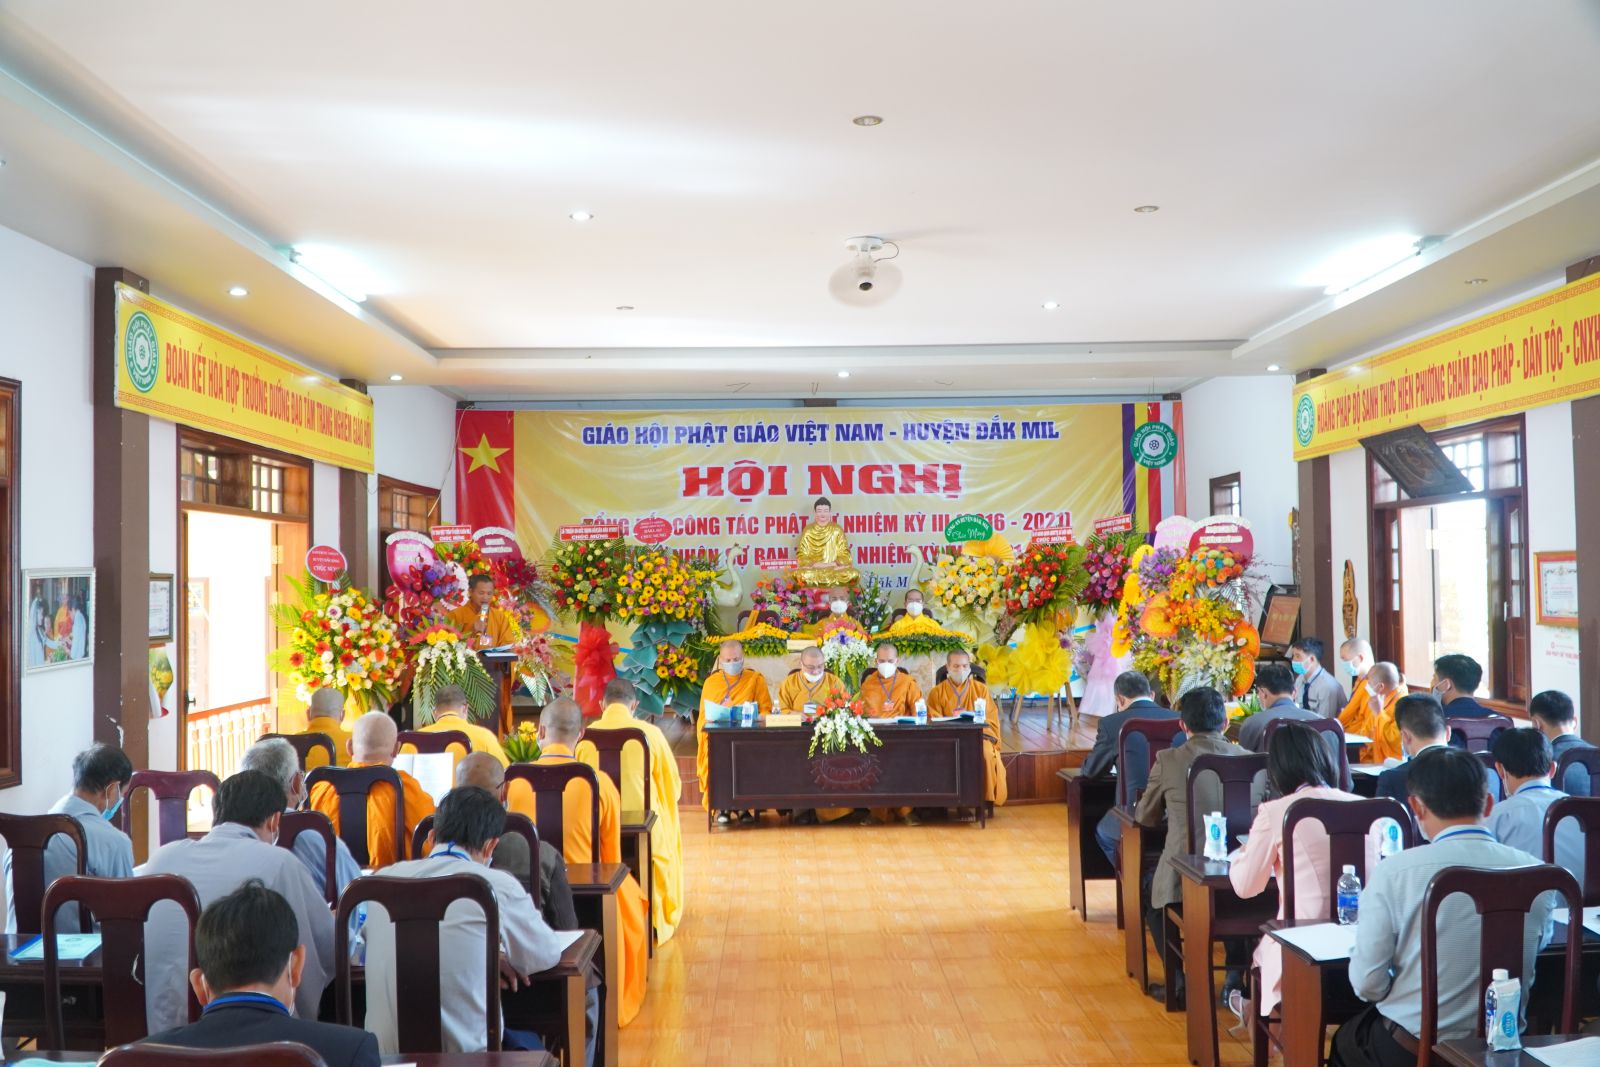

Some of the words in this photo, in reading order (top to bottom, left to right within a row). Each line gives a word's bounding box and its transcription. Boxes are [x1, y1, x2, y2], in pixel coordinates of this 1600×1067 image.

[1447, 350, 1470, 400] CHÂM
[1472, 350, 1488, 400] ĐẠO
[1491, 335, 1514, 388] PHÁP
[1522, 326, 1542, 380] DÂN
[1544, 319, 1563, 382] TỘC
[1573, 313, 1600, 366] CNXH
[165, 338, 189, 390] ĐOÀN
[192, 343, 206, 395] KẾT
[208, 352, 223, 400] HÒA
[225, 364, 240, 413] HỢP
[582, 422, 629, 444] GIÁO
[635, 422, 668, 447] HỘI
[674, 421, 728, 447] PHẬT
[733, 420, 779, 443] GIÁO
[785, 420, 829, 445] VIỆT
[835, 423, 883, 442] NAM
[903, 419, 970, 444] HUYỆN
[976, 415, 1016, 440] ĐẮK
[1021, 421, 1060, 440] MIL
[682, 459, 787, 502] HỘI
[807, 463, 962, 499] NGHỊ
[673, 513, 724, 536] CÔNG
[726, 513, 761, 535] TÁC
[765, 512, 809, 537] PHẬT
[843, 512, 898, 536] NHIỆM
[905, 511, 928, 533] KỲ
[725, 545, 750, 569] Ự
[754, 547, 789, 566] BAN
[856, 543, 911, 567] NHIỆM
